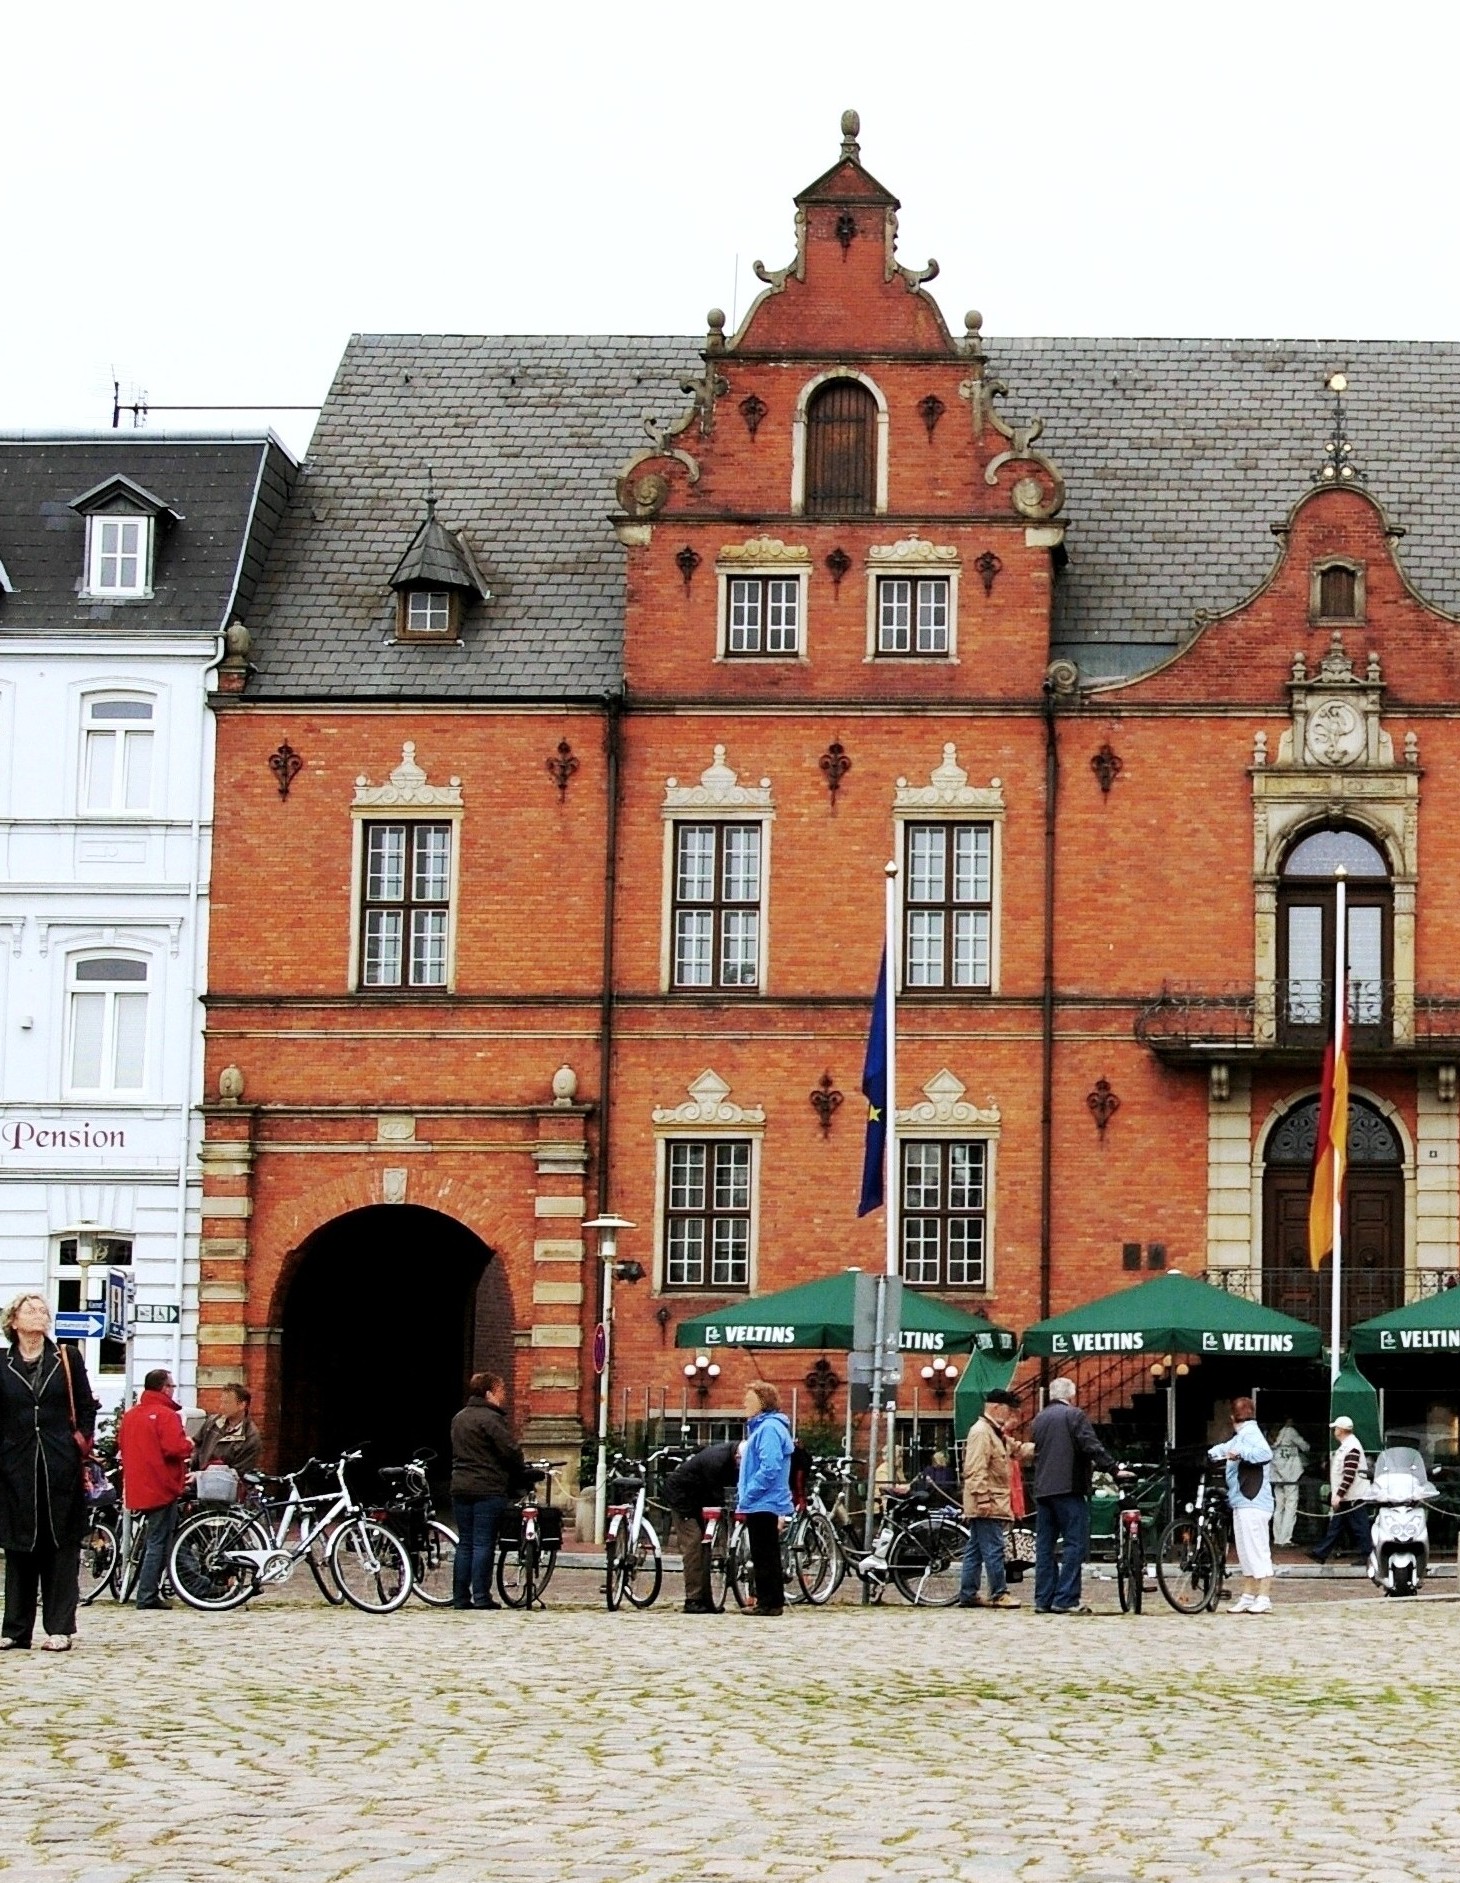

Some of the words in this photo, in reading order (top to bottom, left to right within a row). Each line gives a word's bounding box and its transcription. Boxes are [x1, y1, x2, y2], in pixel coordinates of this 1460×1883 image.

[1, 1121, 126, 1150] Pension
[725, 1326, 795, 1343] VELTINS
[899, 1331, 945, 1350] LTINS
[1072, 1332, 1144, 1351] VELTINS
[1221, 1333, 1294, 1352] VELTINS
